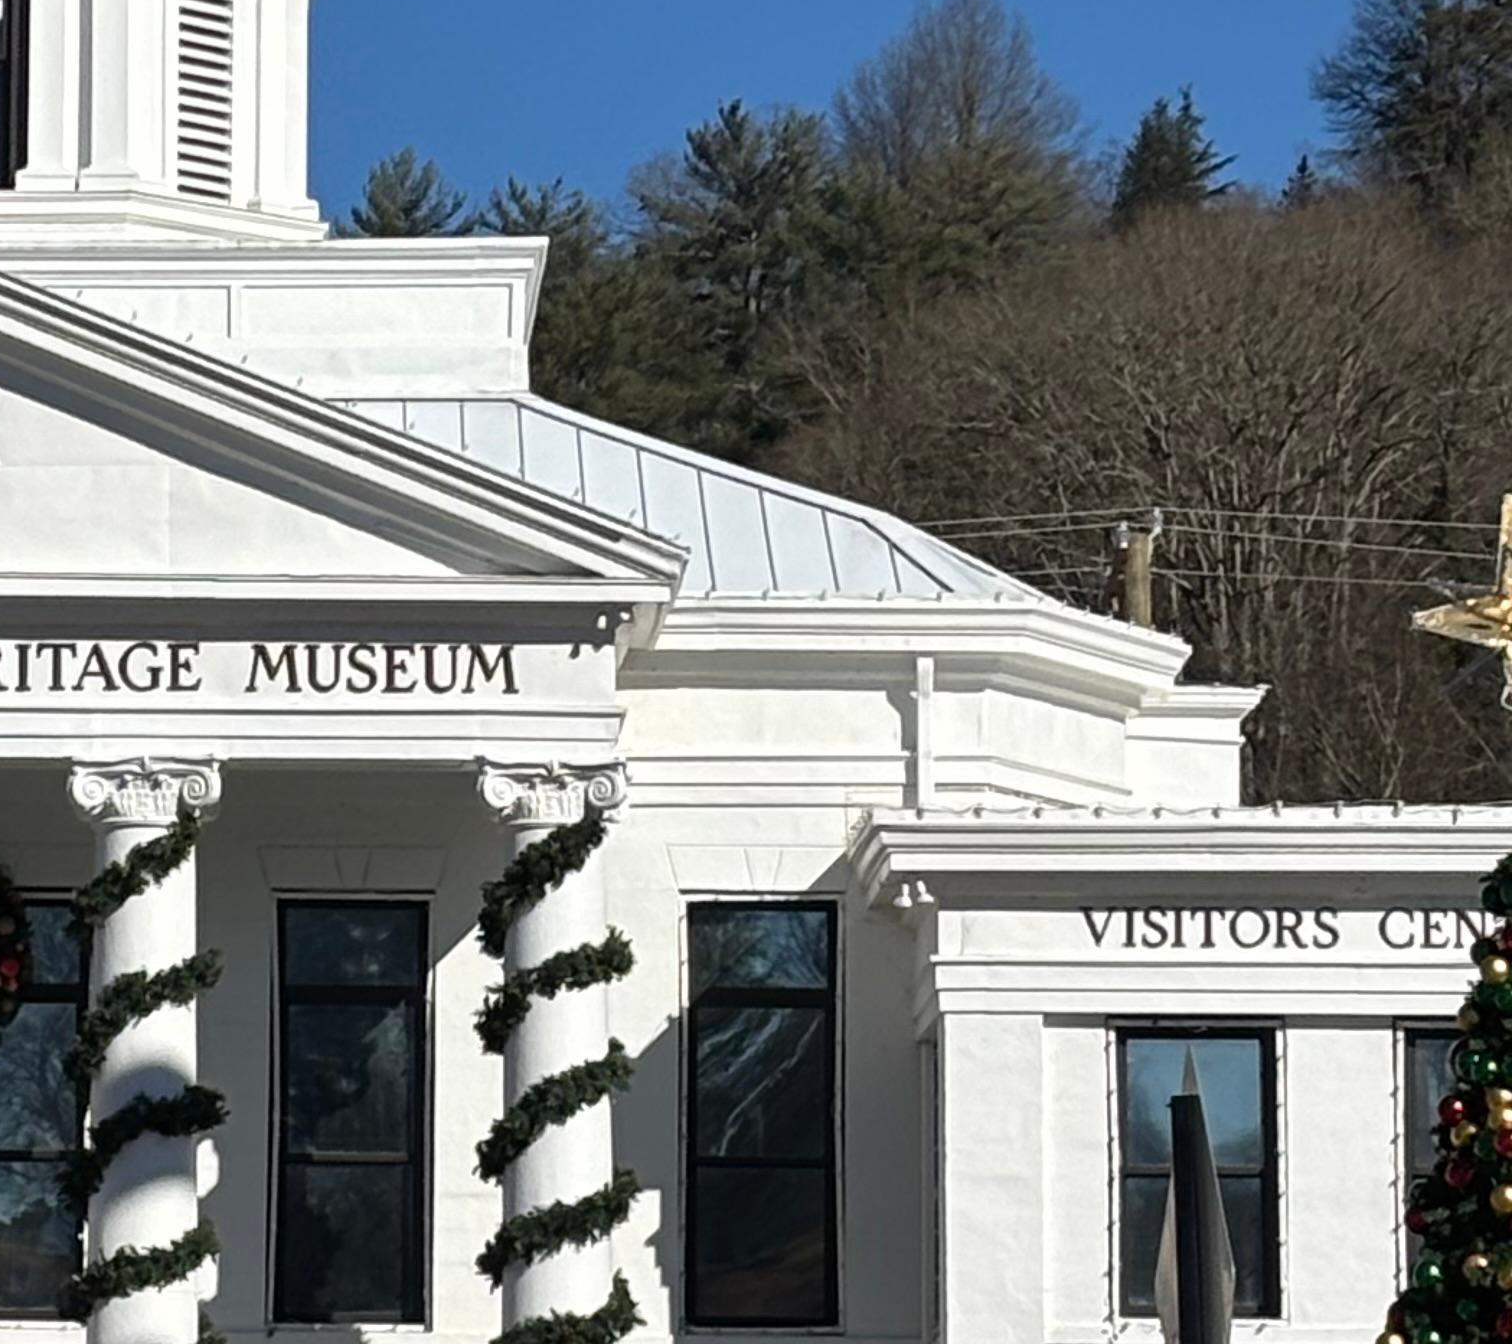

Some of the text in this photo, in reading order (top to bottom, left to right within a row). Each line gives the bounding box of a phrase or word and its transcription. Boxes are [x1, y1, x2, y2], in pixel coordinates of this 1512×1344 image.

[244, 644, 519, 695] MUSEUM
[1079, 907, 1498, 949] VISITORS CEN
